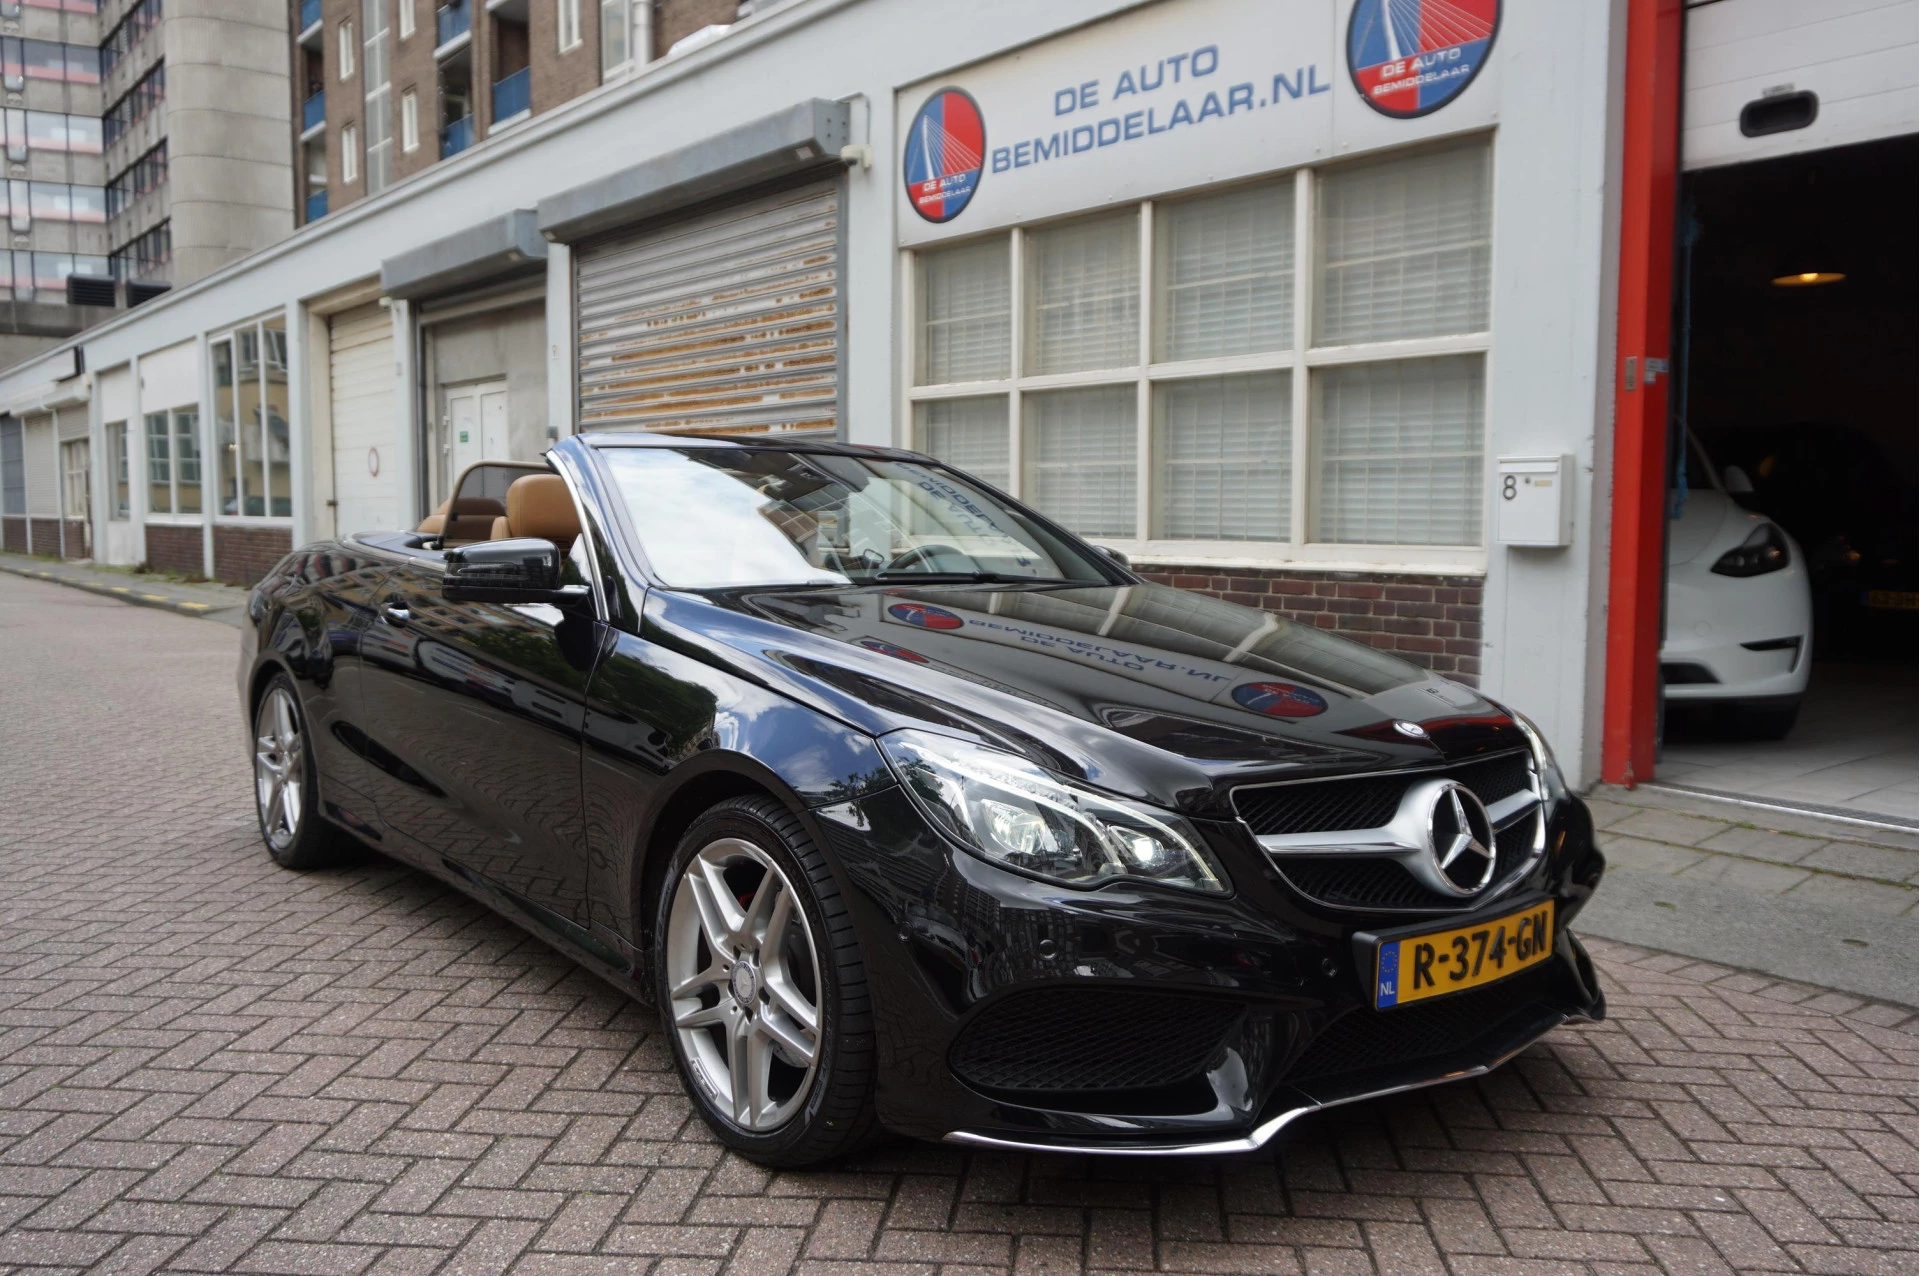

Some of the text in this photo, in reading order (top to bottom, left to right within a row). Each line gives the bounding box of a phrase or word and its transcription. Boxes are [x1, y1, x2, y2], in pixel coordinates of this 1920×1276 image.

[1381, 47, 1462, 78] DE AUTO
[1054, 43, 1219, 117] DE AUTO
[1372, 64, 1470, 95] BEMIDDELAAR
[991, 63, 1332, 174] BEMIDDELAAR.NL
[918, 185, 972, 204] BEMIDDELAAR
[922, 173, 967, 192] DE AUTO
[1502, 474, 1517, 501] 8
[1413, 910, 1548, 990] R-374-GN
[1379, 981, 1396, 997] NL
